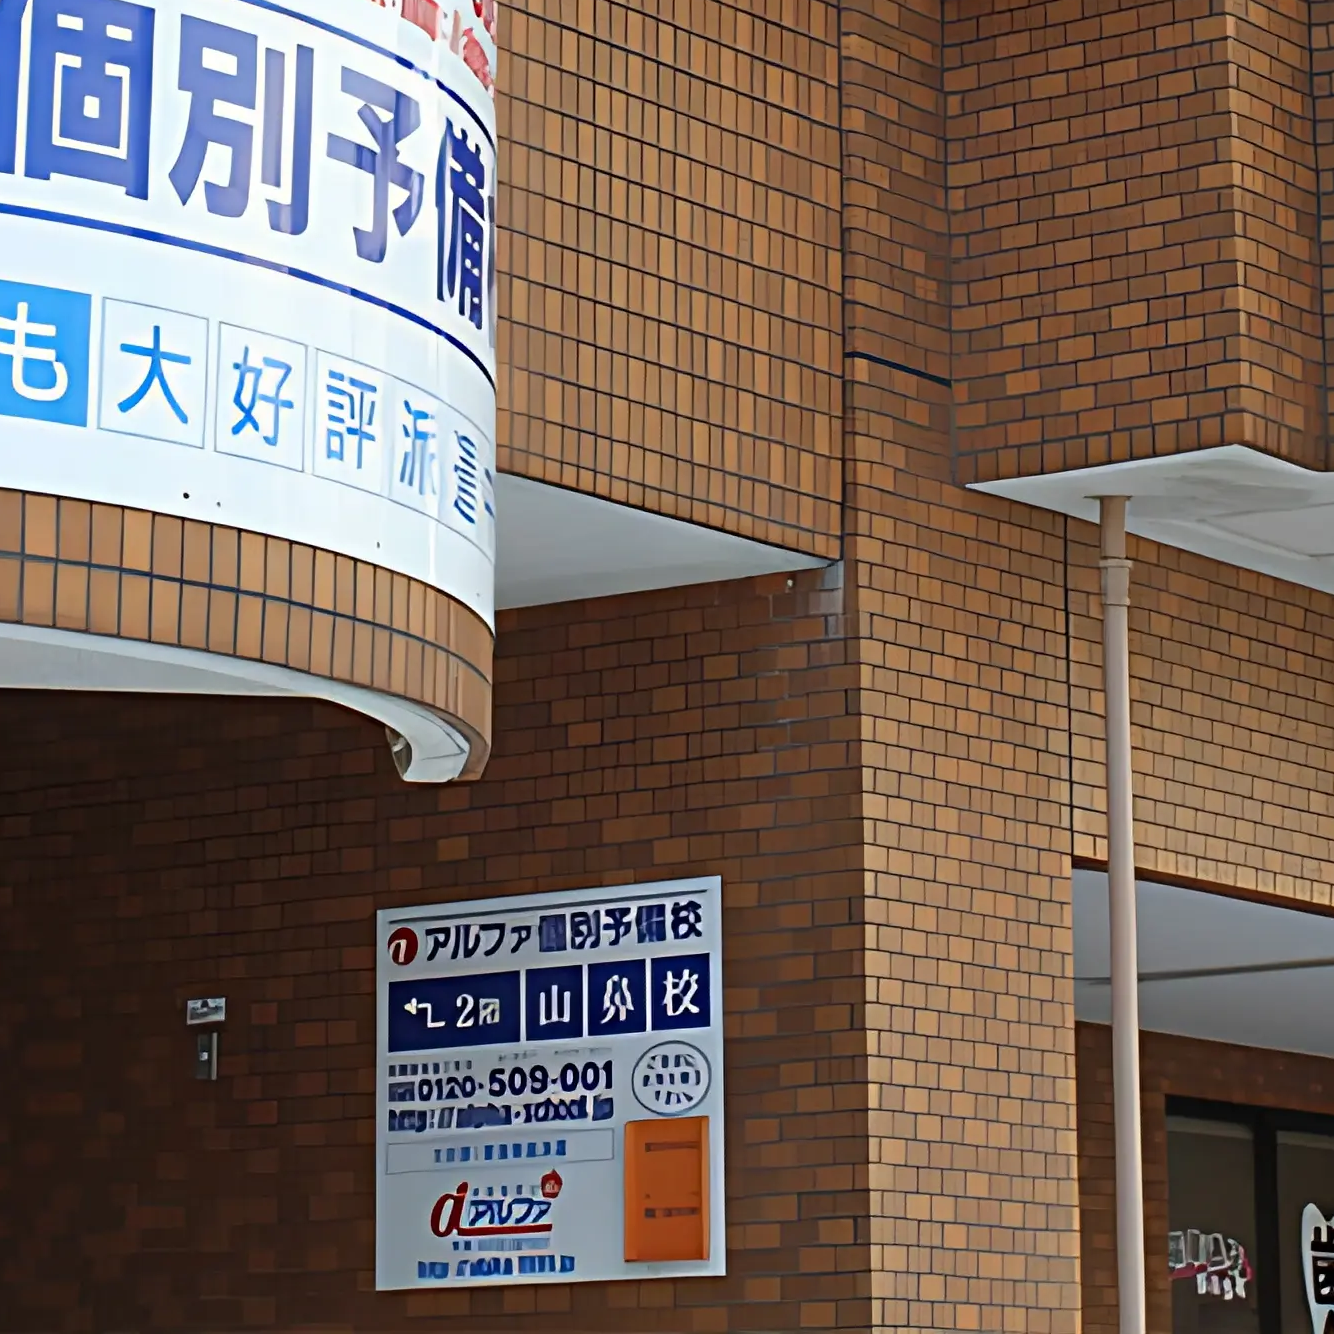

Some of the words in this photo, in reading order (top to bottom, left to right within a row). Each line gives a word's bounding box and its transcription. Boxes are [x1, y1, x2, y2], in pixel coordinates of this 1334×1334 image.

[425, 901, 703, 962] アルファ別予校
